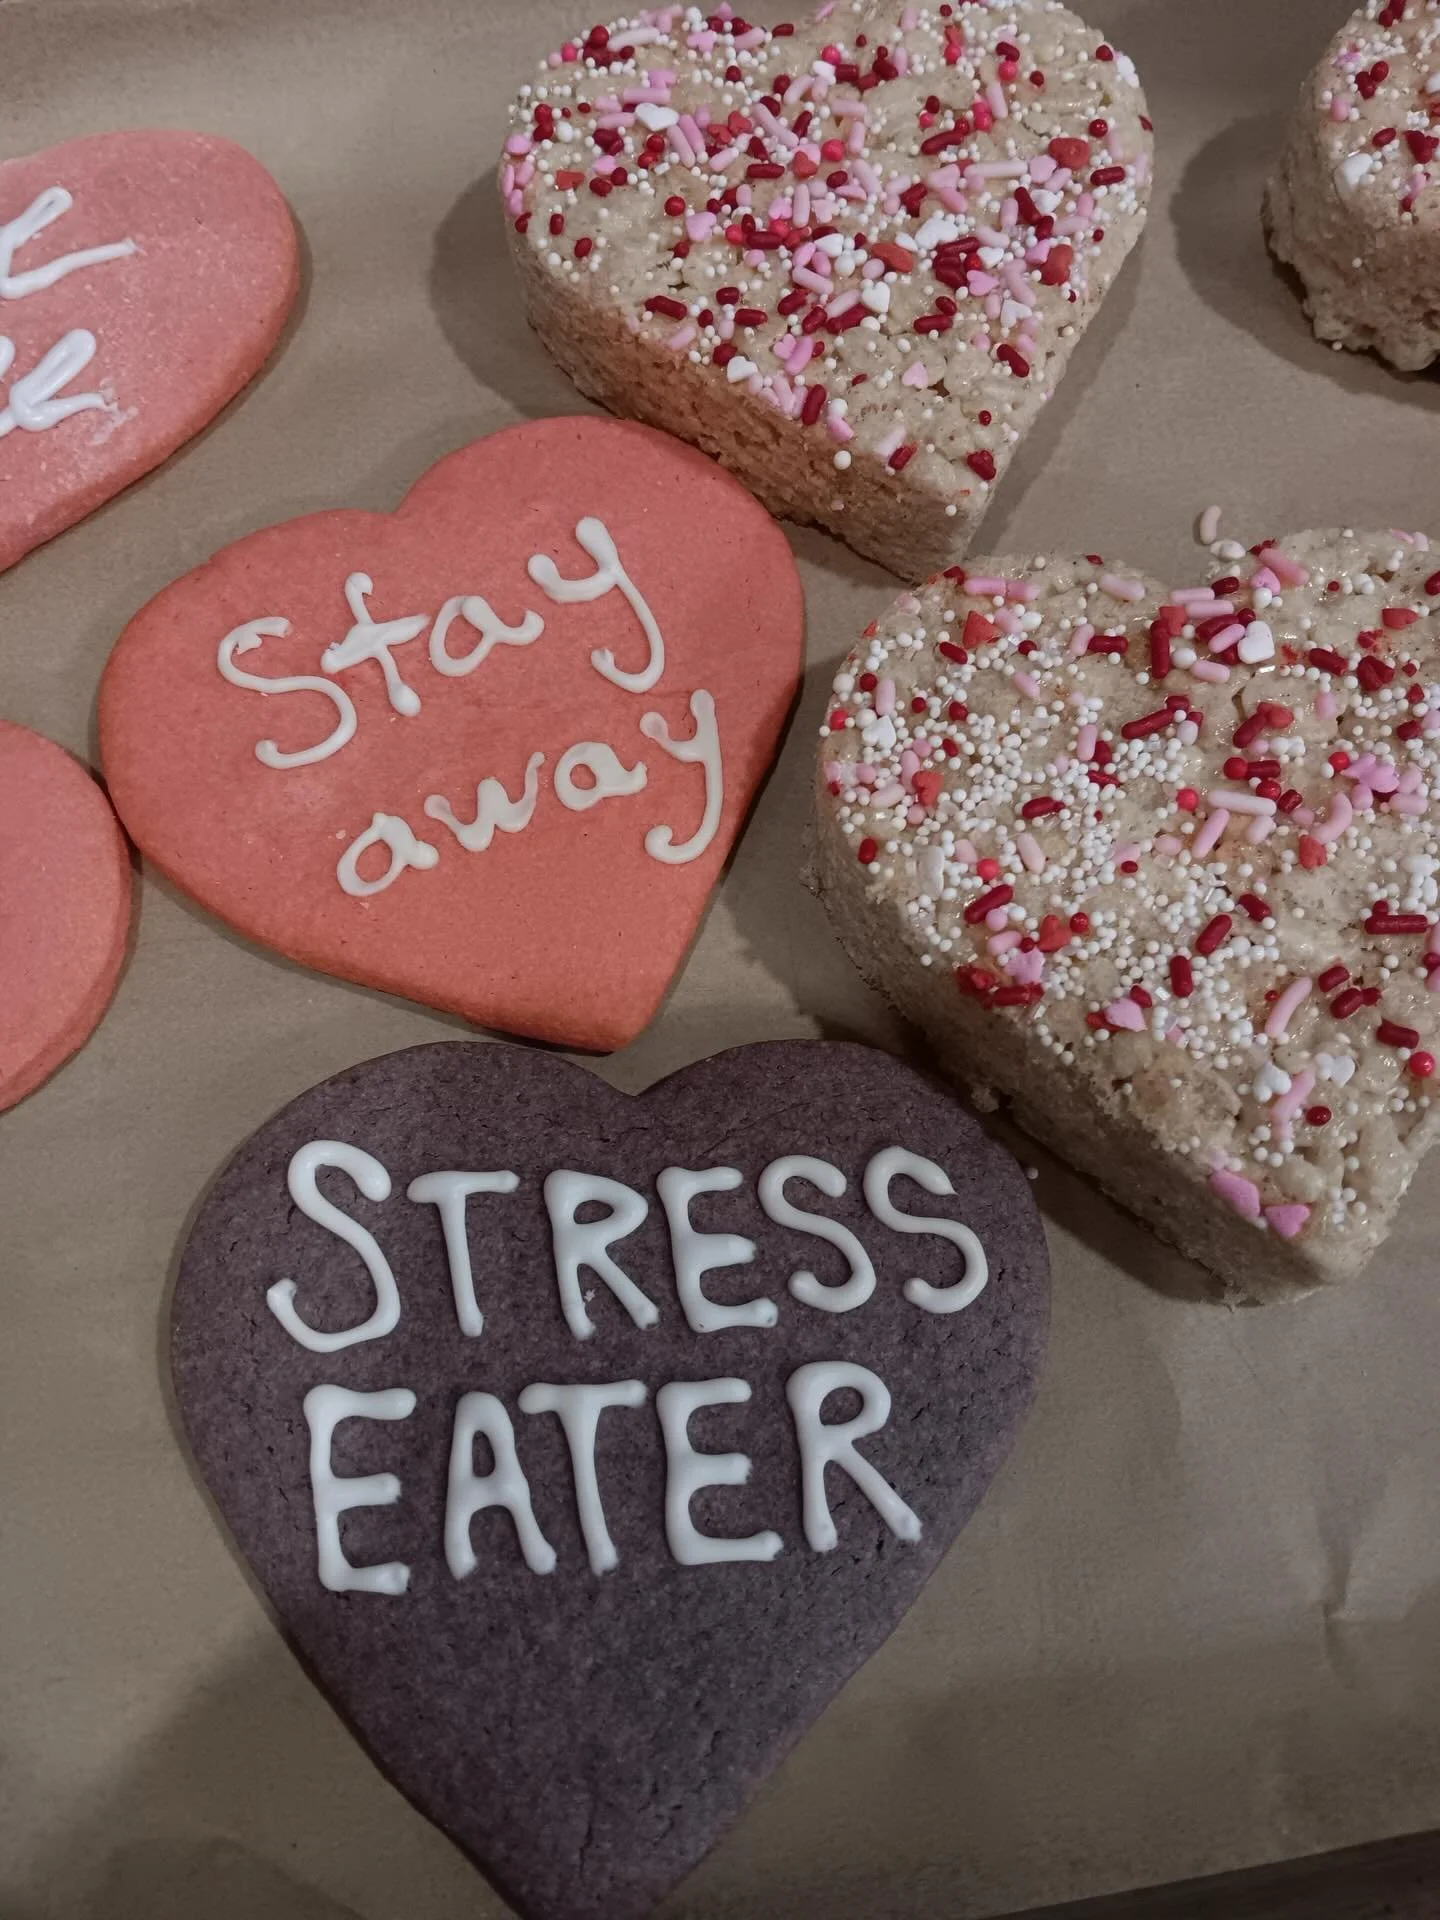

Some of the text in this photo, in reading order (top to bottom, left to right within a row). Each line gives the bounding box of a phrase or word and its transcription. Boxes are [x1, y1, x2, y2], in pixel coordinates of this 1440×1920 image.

[217, 516, 665, 770] Stay
[336, 689, 724, 897] away
[266, 1139, 990, 1354] STRESS
[302, 1360, 924, 1596] EATER
